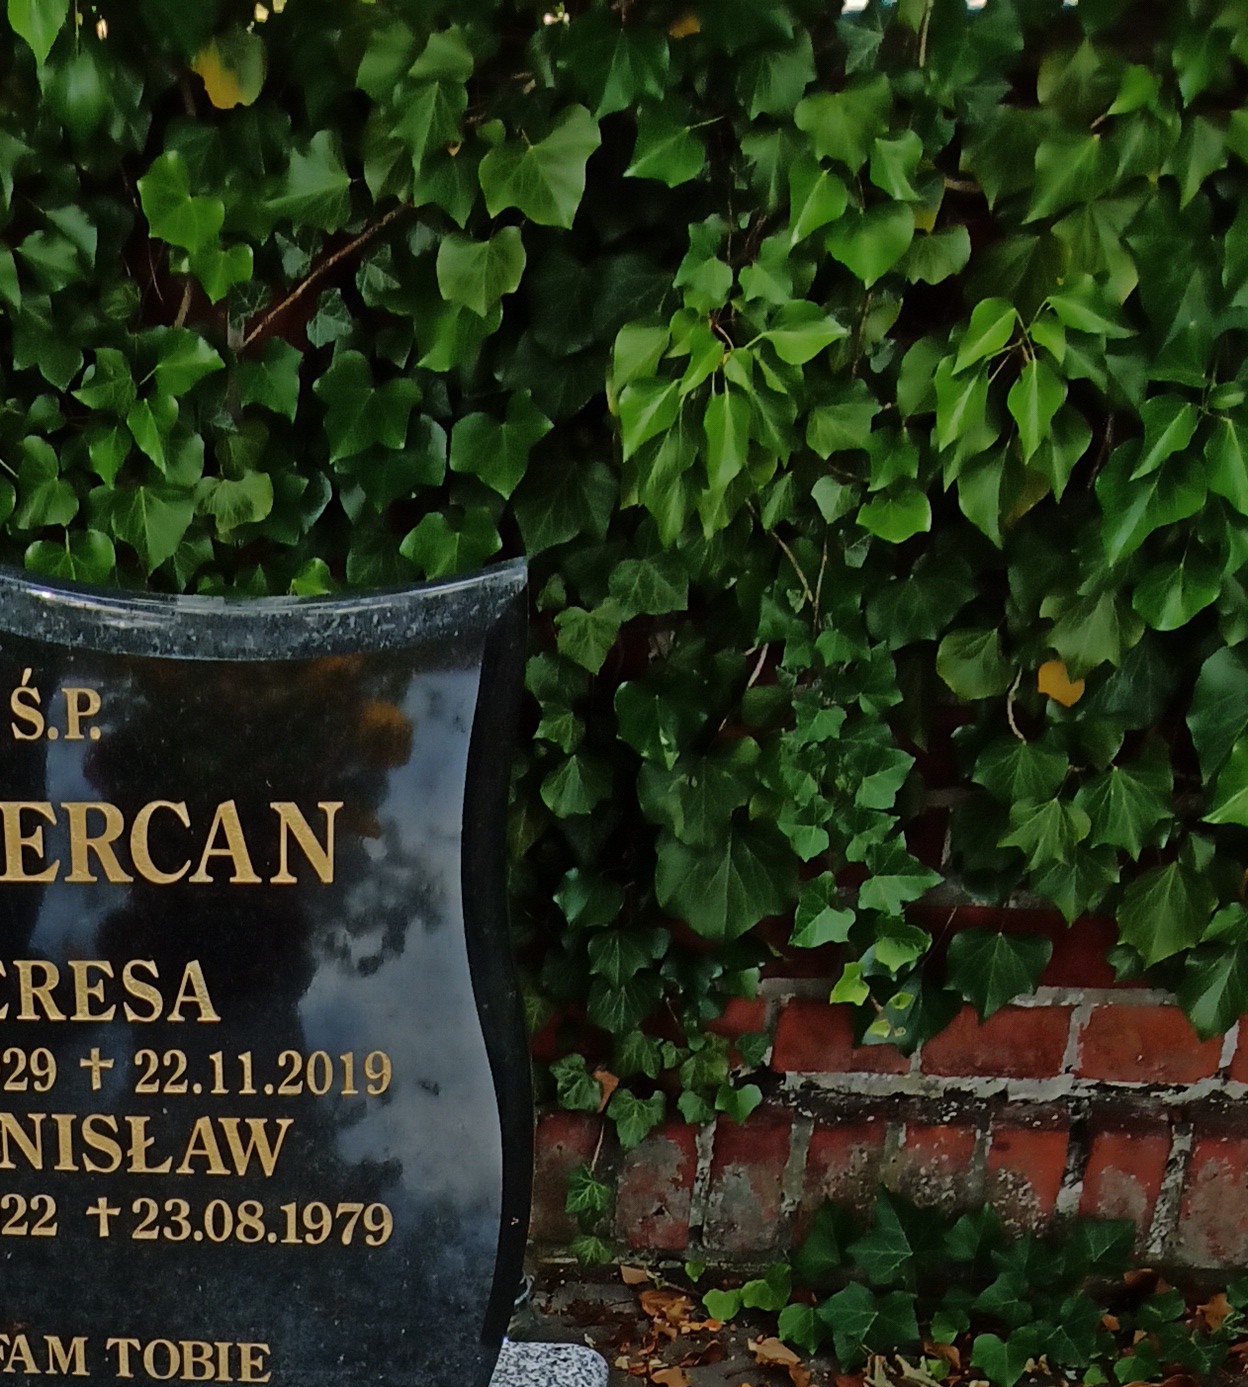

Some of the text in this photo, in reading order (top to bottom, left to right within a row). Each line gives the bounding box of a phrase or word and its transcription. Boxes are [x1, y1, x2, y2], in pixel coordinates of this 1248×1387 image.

[10, 668, 102, 741] Ś.P.
[133, 1049, 392, 1095] 22.11.2019
[130, 1197, 393, 1246] 23.08.1979
[105, 1336, 272, 1382] TOBIE
